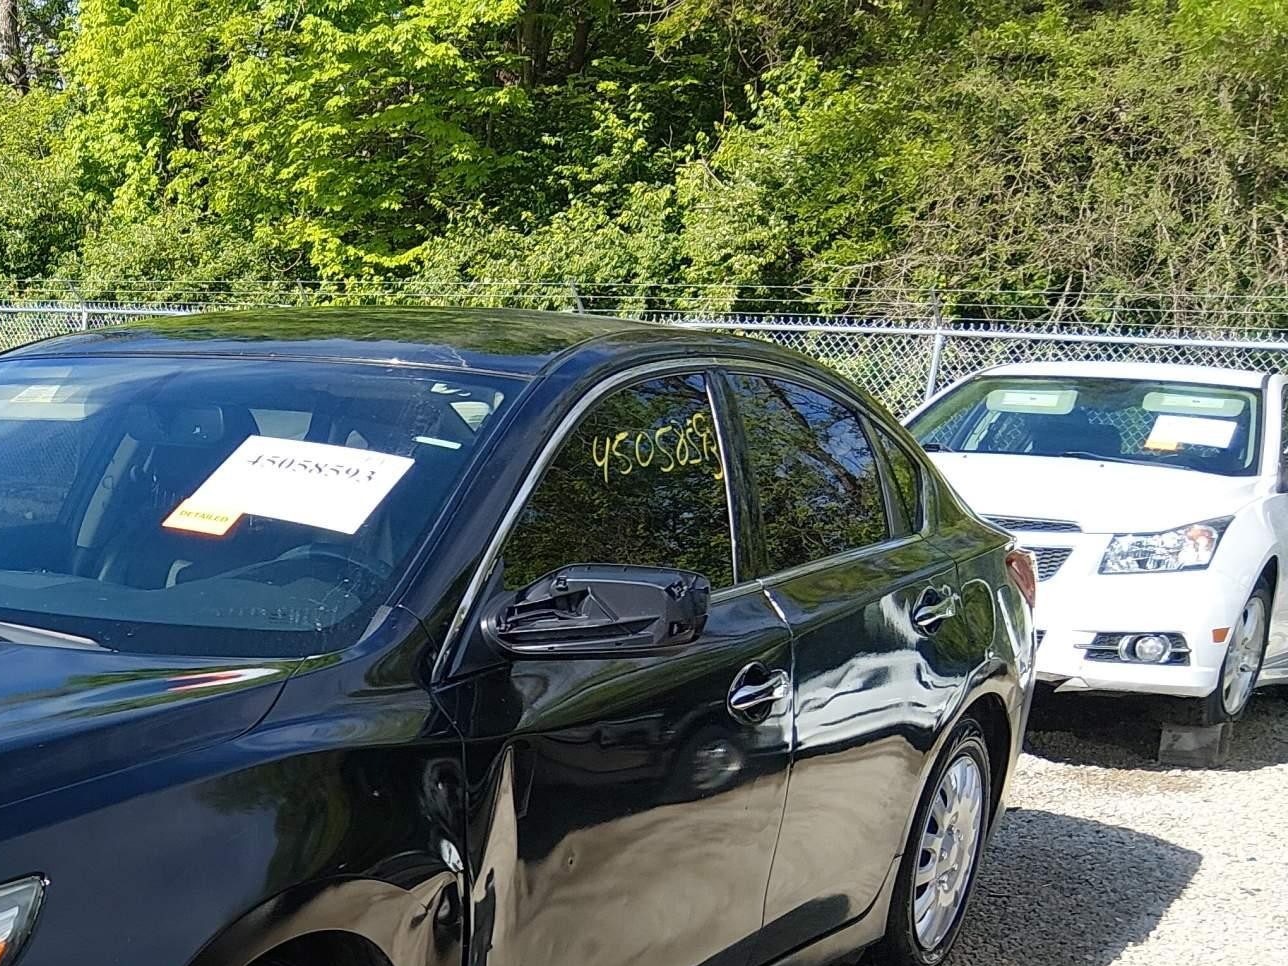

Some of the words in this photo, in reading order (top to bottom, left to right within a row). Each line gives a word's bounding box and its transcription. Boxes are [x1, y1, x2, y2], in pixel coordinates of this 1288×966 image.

[592, 413, 724, 484] 45058593
[248, 454, 378, 484] 45058593
[179, 509, 230, 524] DETAILED
